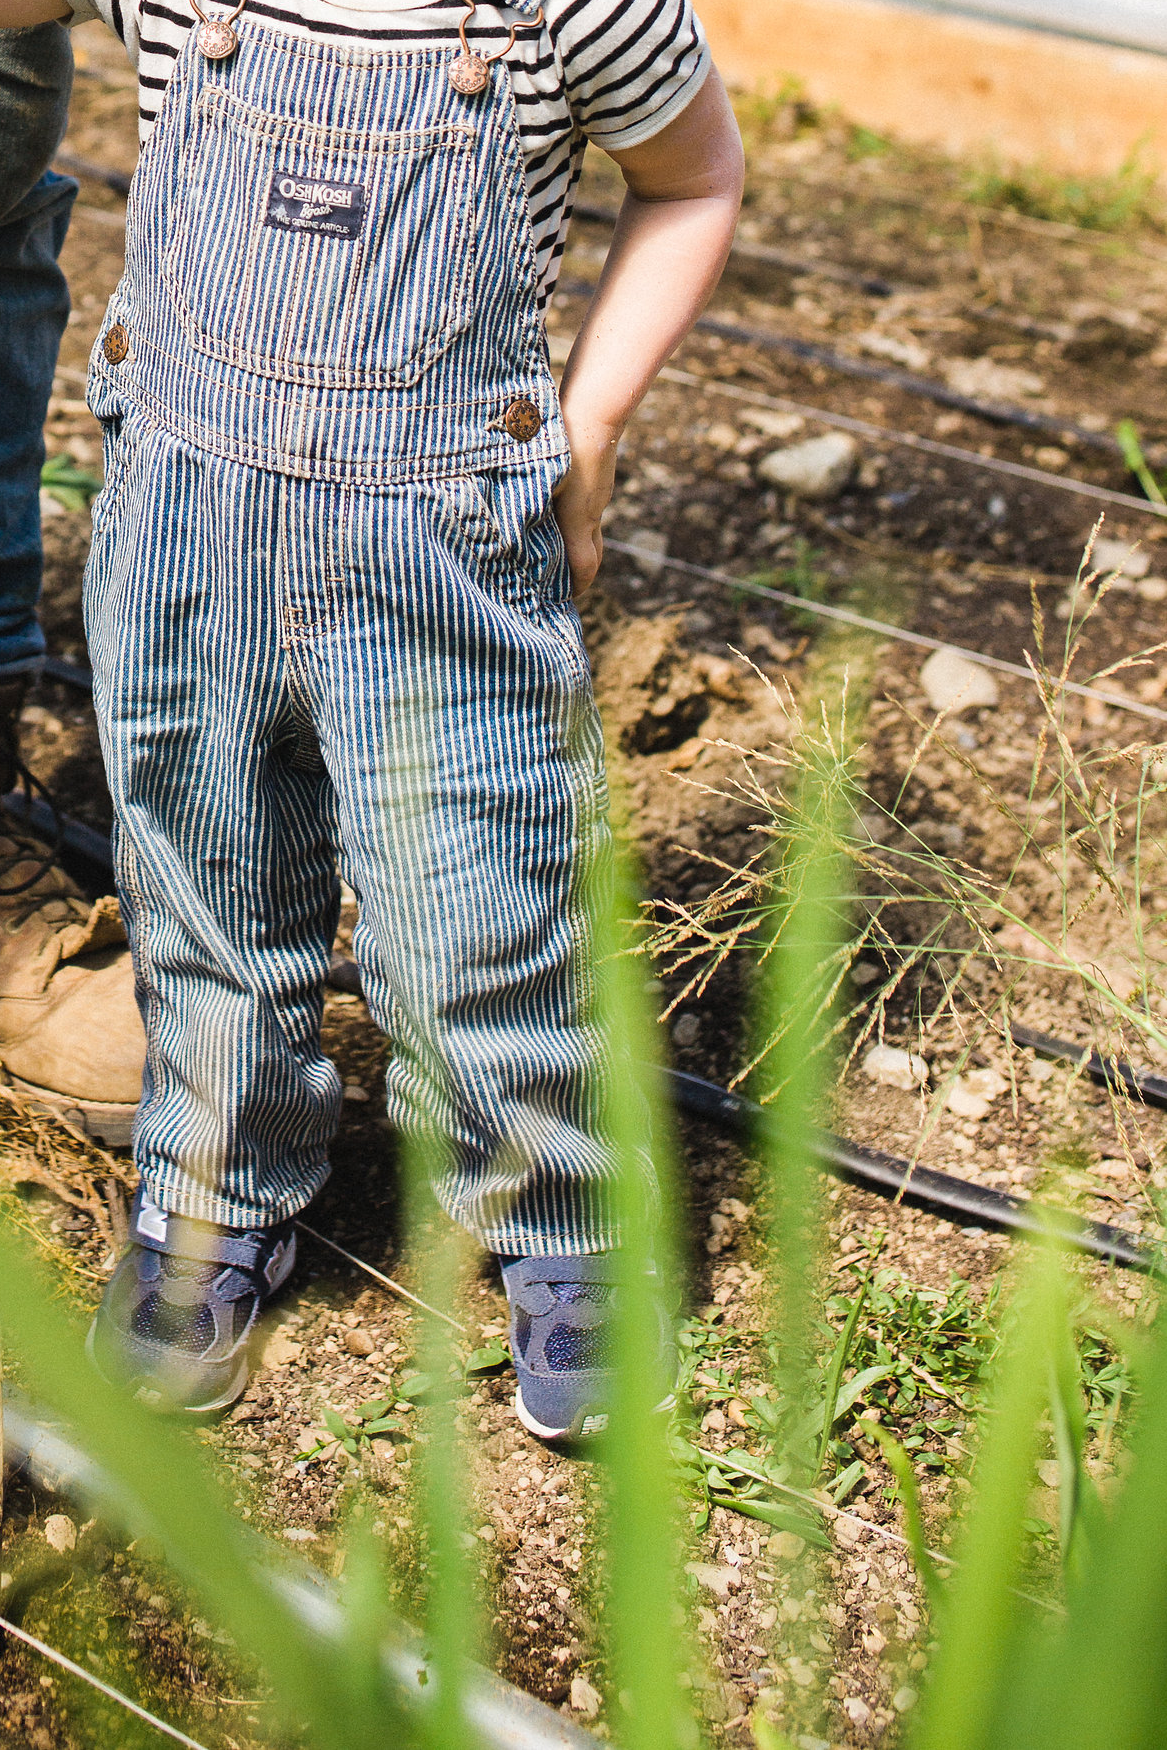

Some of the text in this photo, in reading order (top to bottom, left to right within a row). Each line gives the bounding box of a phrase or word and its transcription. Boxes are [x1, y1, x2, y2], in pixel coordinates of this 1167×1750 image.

[276, 215, 291, 225] THE
[291, 219, 319, 229] GENUINE
[581, 1413, 609, 1435] NB
